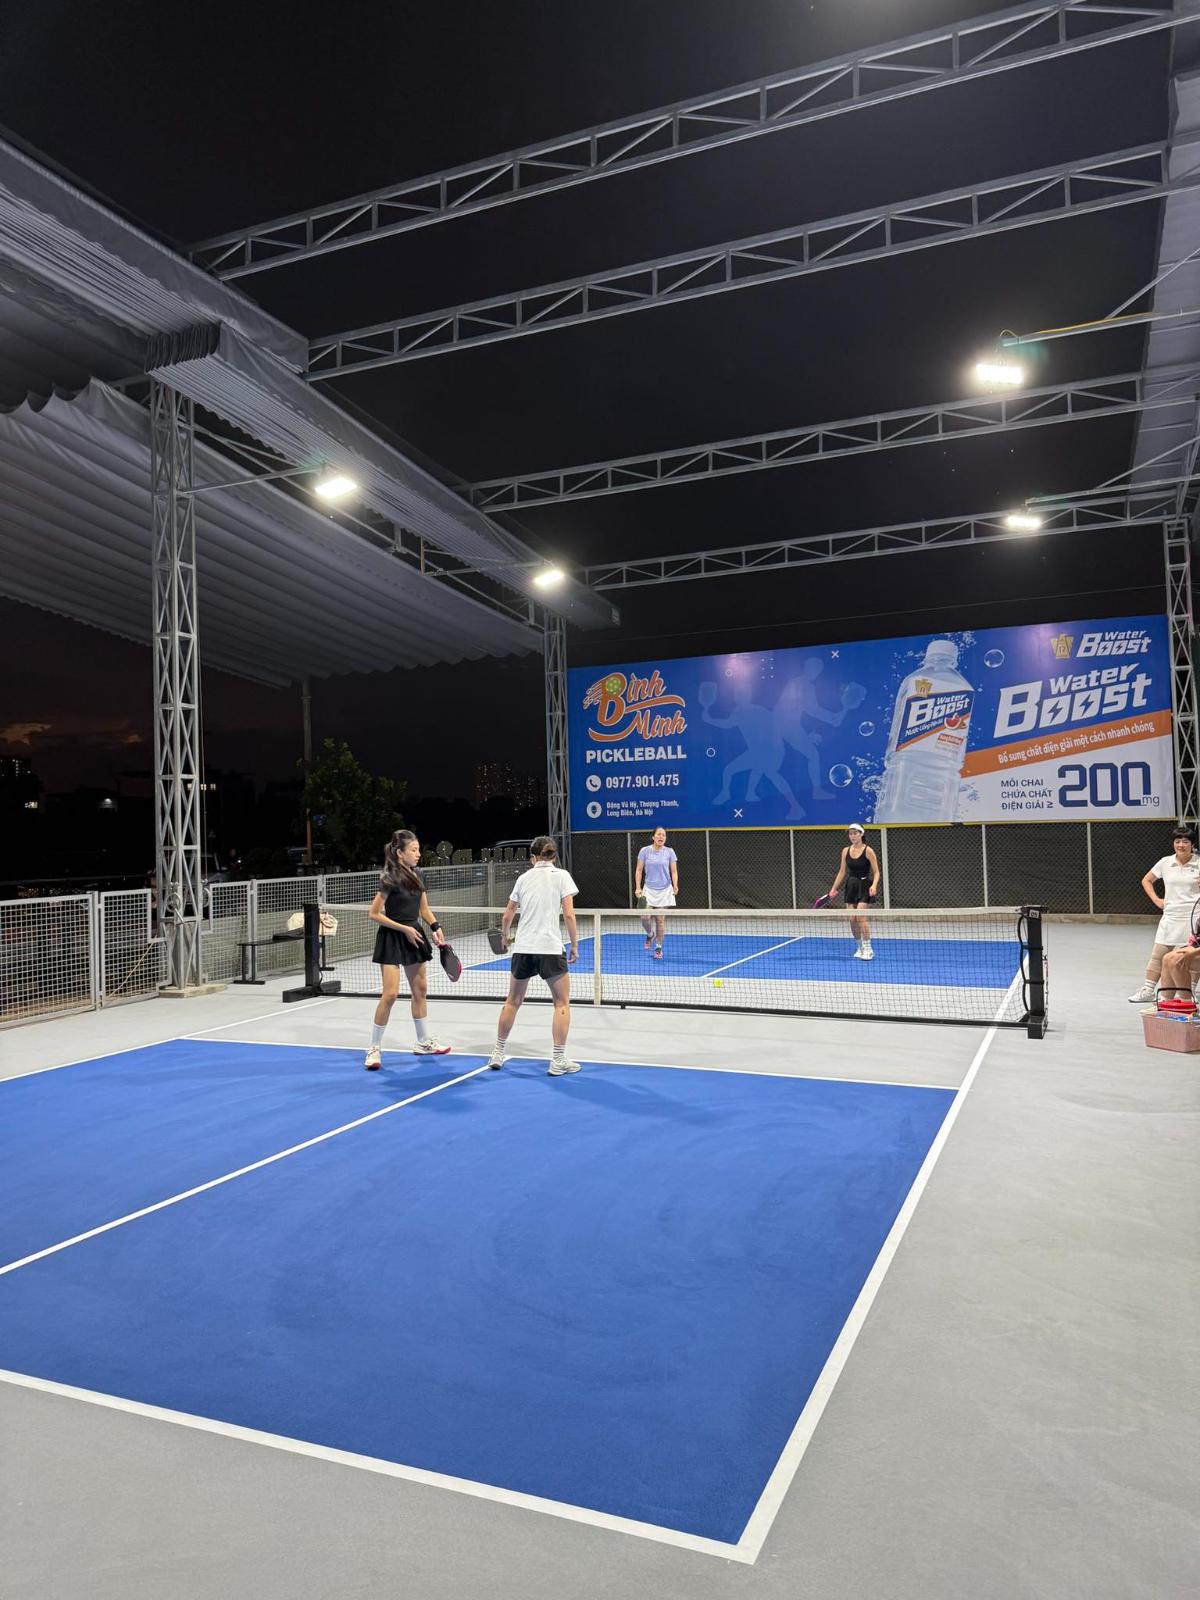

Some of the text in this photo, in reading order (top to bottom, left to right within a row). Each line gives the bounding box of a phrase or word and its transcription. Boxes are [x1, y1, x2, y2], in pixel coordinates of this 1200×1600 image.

[1104, 630, 1147, 640] Water
[1076, 633, 1152, 657] Boost
[1049, 662, 1140, 695] Water
[584, 670, 667, 727] Bình
[937, 694, 967, 705] Water
[993, 673, 1152, 739] Boost
[1009, 751, 1027, 761] sung
[1027, 745, 1042, 756] chất
[1043, 741, 1059, 755] điện
[1060, 737, 1073, 752] giải
[1074, 733, 1090, 748] một
[1090, 730, 1107, 742] cách
[1107, 725, 1131, 738] nhanh
[1131, 720, 1155, 734] chóng
[586, 745, 687, 763] PICKLEBALL
[605, 773, 680, 788] 0977.901.475
[1021, 779, 1043, 787] CHAI
[1058, 761, 1159, 807] 200 mg
[1001, 787, 1052, 798] CHỨA CHẤT
[644, 808, 653, 817] Nội
[1001, 801, 1023, 811] ĐIỆN
[1025, 800, 1044, 809] GIẢI
